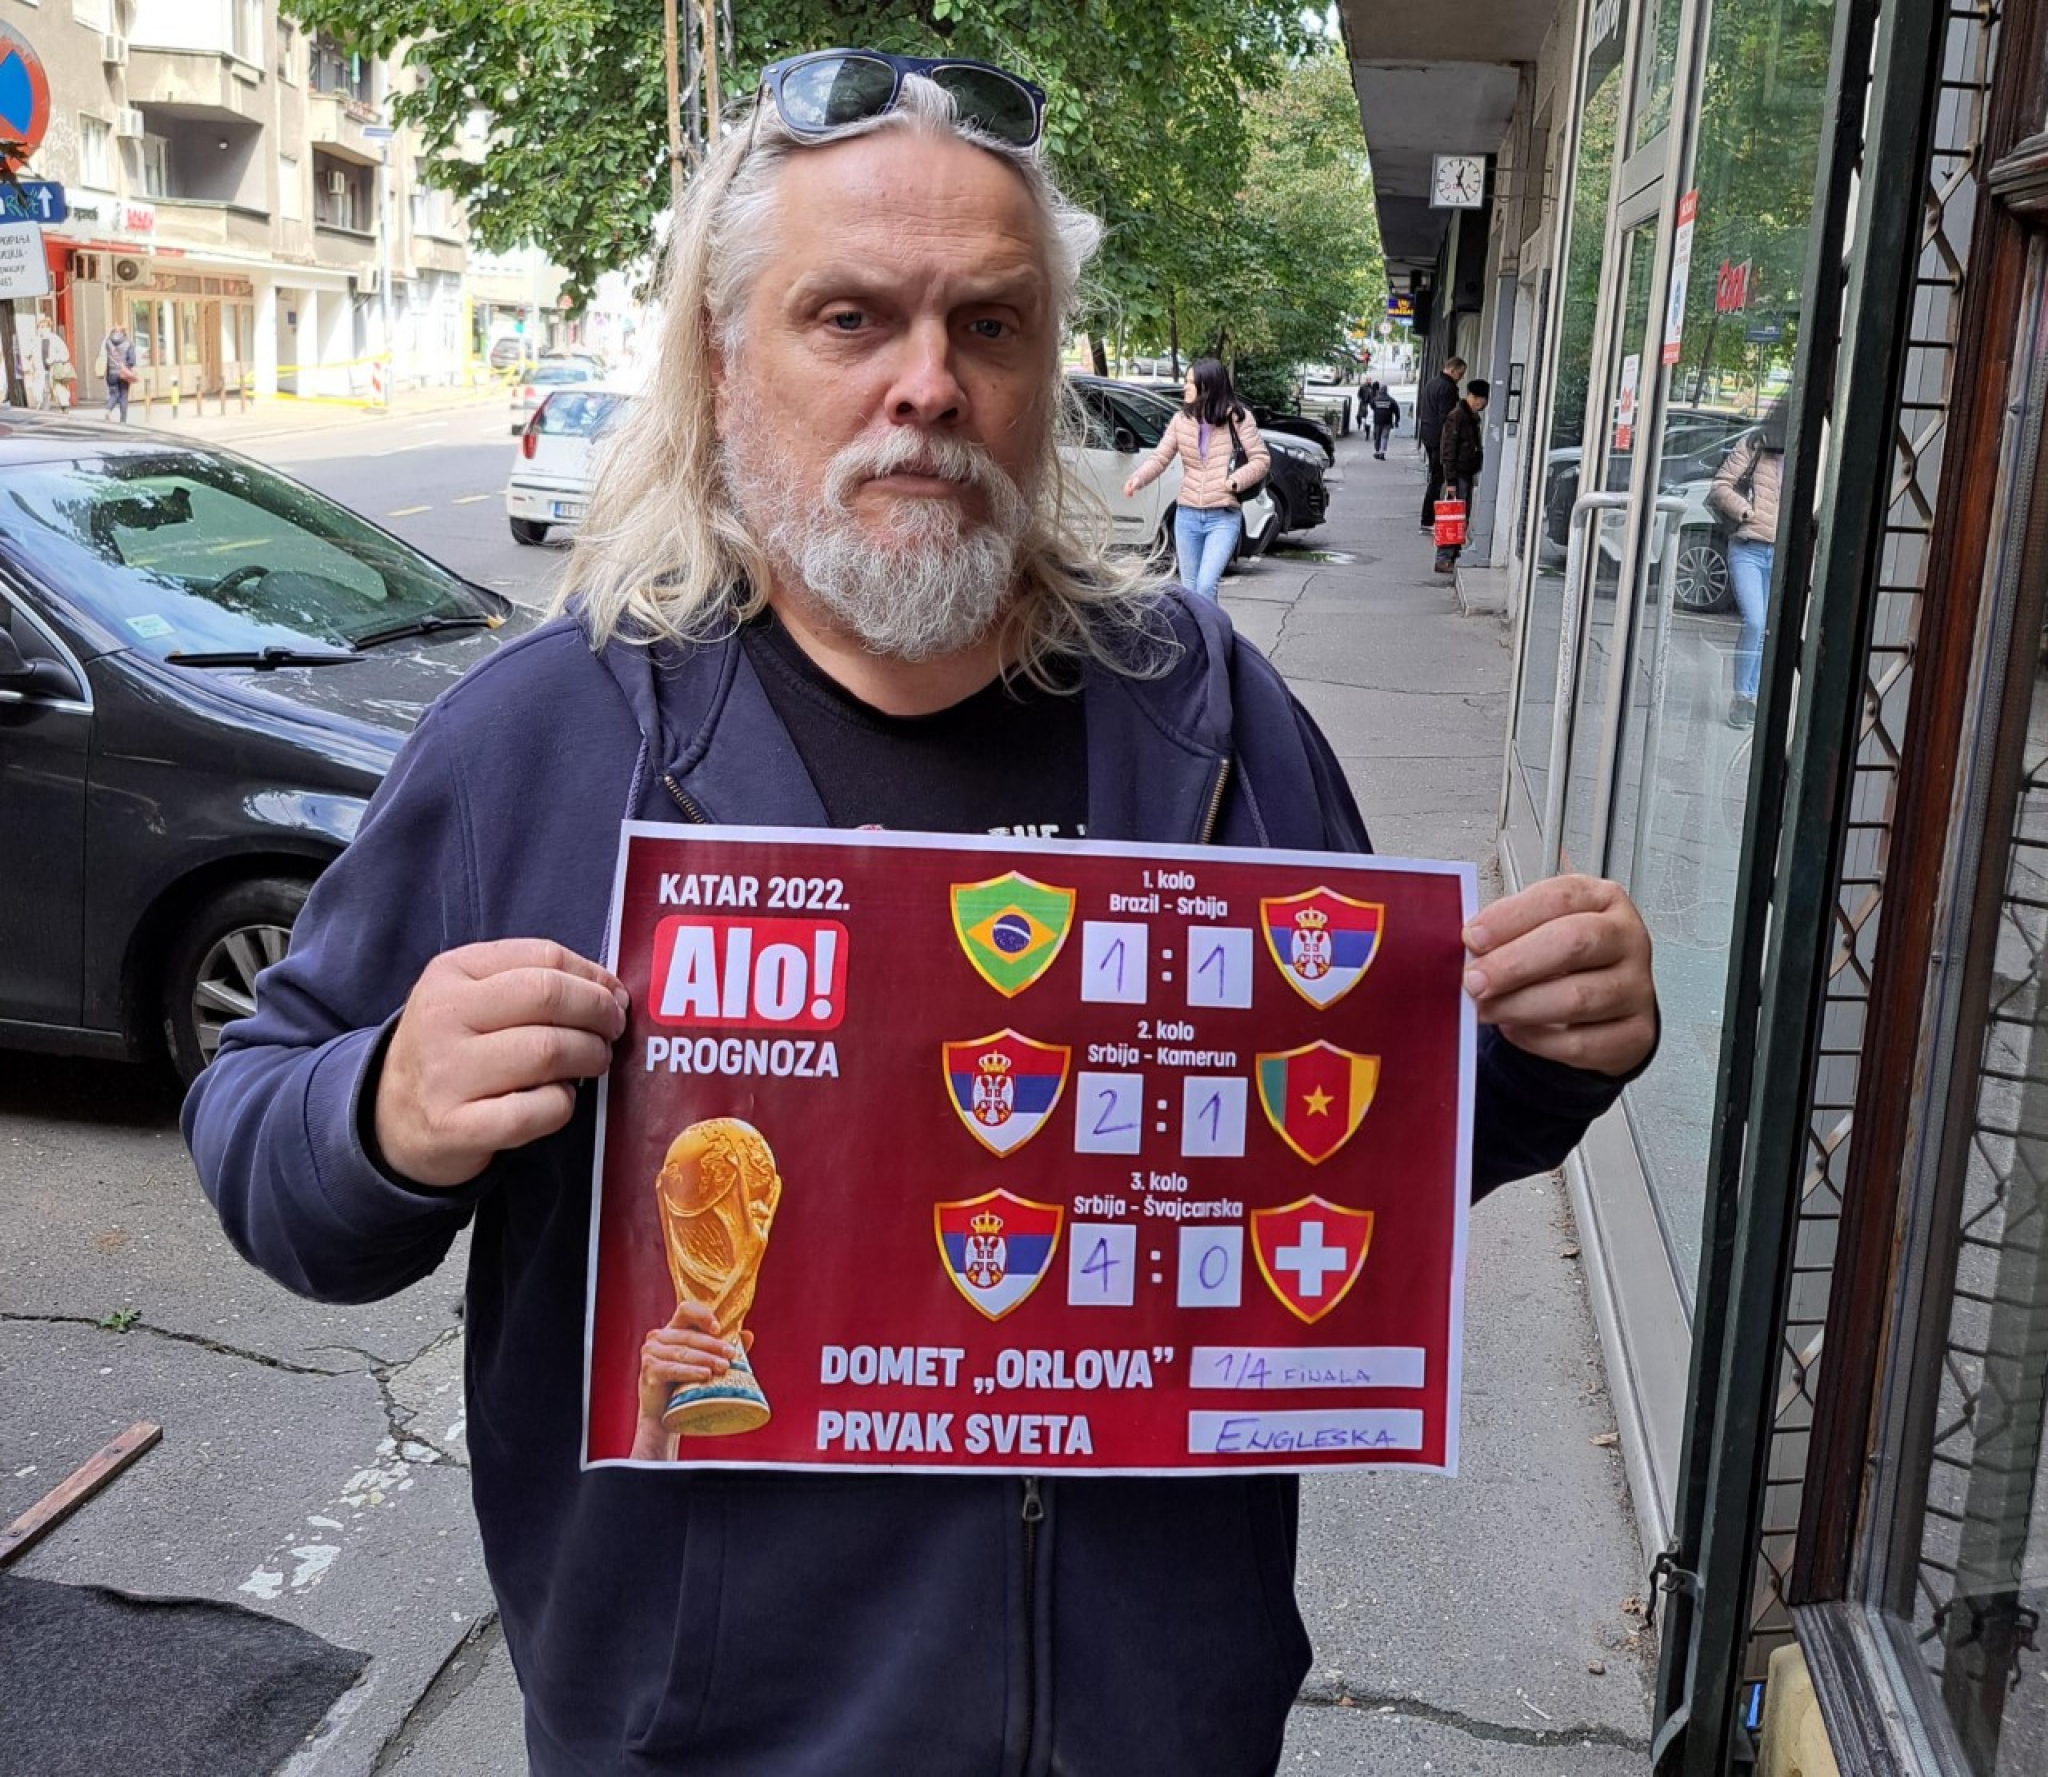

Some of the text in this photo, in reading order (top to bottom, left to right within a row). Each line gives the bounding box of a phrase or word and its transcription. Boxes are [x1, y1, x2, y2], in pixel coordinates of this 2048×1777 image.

[659, 873, 850, 910] KATAR 2022.
[1143, 870, 1195, 890] 1. kolo
[1110, 894, 1159, 913] Brazil
[1177, 896, 1227, 919] Srbija
[659, 925, 837, 1020] Alo!
[1100, 938, 1125, 993] 1
[1198, 944, 1224, 998] 1
[1138, 1020, 1194, 1040] 2. kolo
[646, 1036, 838, 1077] PROGNOZA
[1088, 1043, 1139, 1067] Srbija
[1157, 1047, 1236, 1067] Kamerun
[1093, 1089, 1140, 1135] 2
[1198, 1091, 1221, 1142] 1
[1131, 1171, 1187, 1192] 3. kolo
[1074, 1195, 1125, 1219] Srbija
[1144, 1195, 1242, 1221] Švajcarska
[1081, 1238, 1120, 1292] 4
[1199, 1246, 1227, 1289] 0
[821, 1345, 965, 1387] DOMET
[1214, 1352, 1272, 1388] 1/4
[816, 1411, 1093, 1454] PRVAK SVETA
